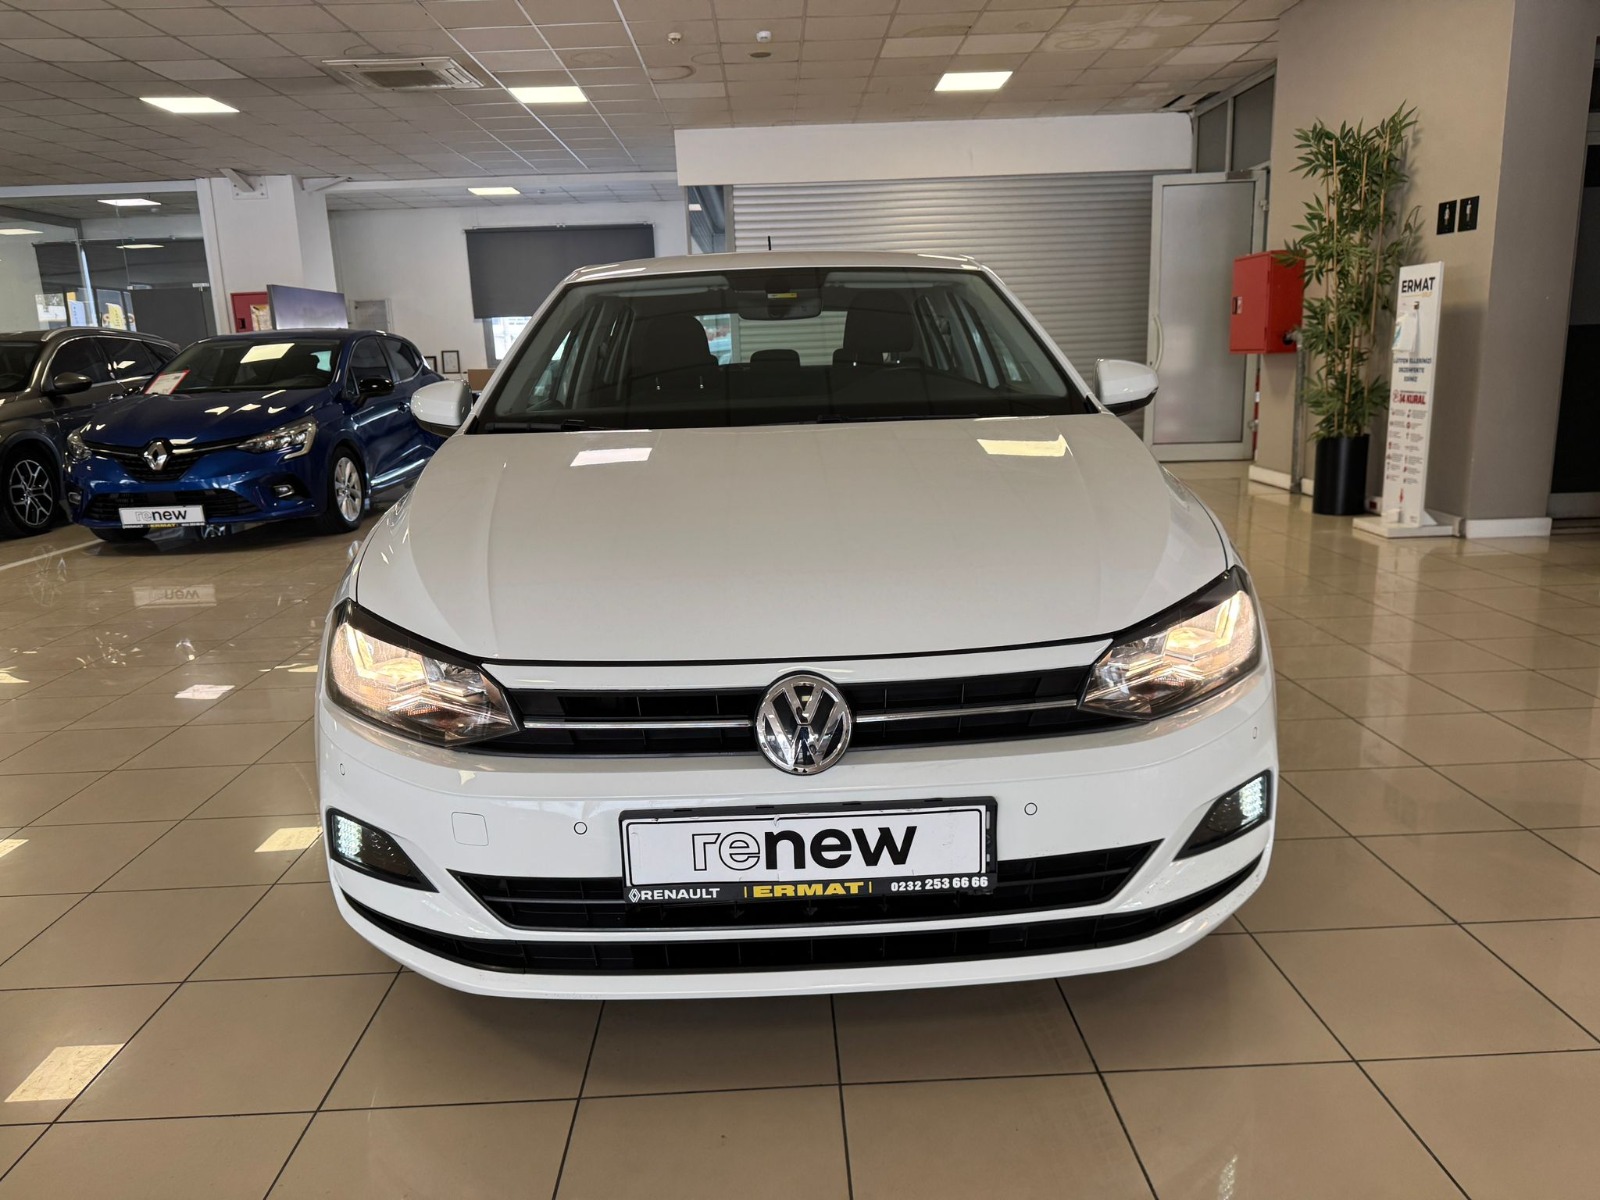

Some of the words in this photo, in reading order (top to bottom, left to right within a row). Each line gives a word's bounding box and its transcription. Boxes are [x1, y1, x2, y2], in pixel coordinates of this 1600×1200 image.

[1401, 277, 1436, 293] ERMAT
[135, 510, 187, 522] renew
[692, 825, 917, 871] renew
[640, 888, 720, 900] RENAULT
[753, 881, 864, 898] ERMAT
[890, 881, 922, 891] 0232
[924, 878, 950, 889] 253
[952, 878, 970, 888] 66
[971, 877, 989, 887] 66
